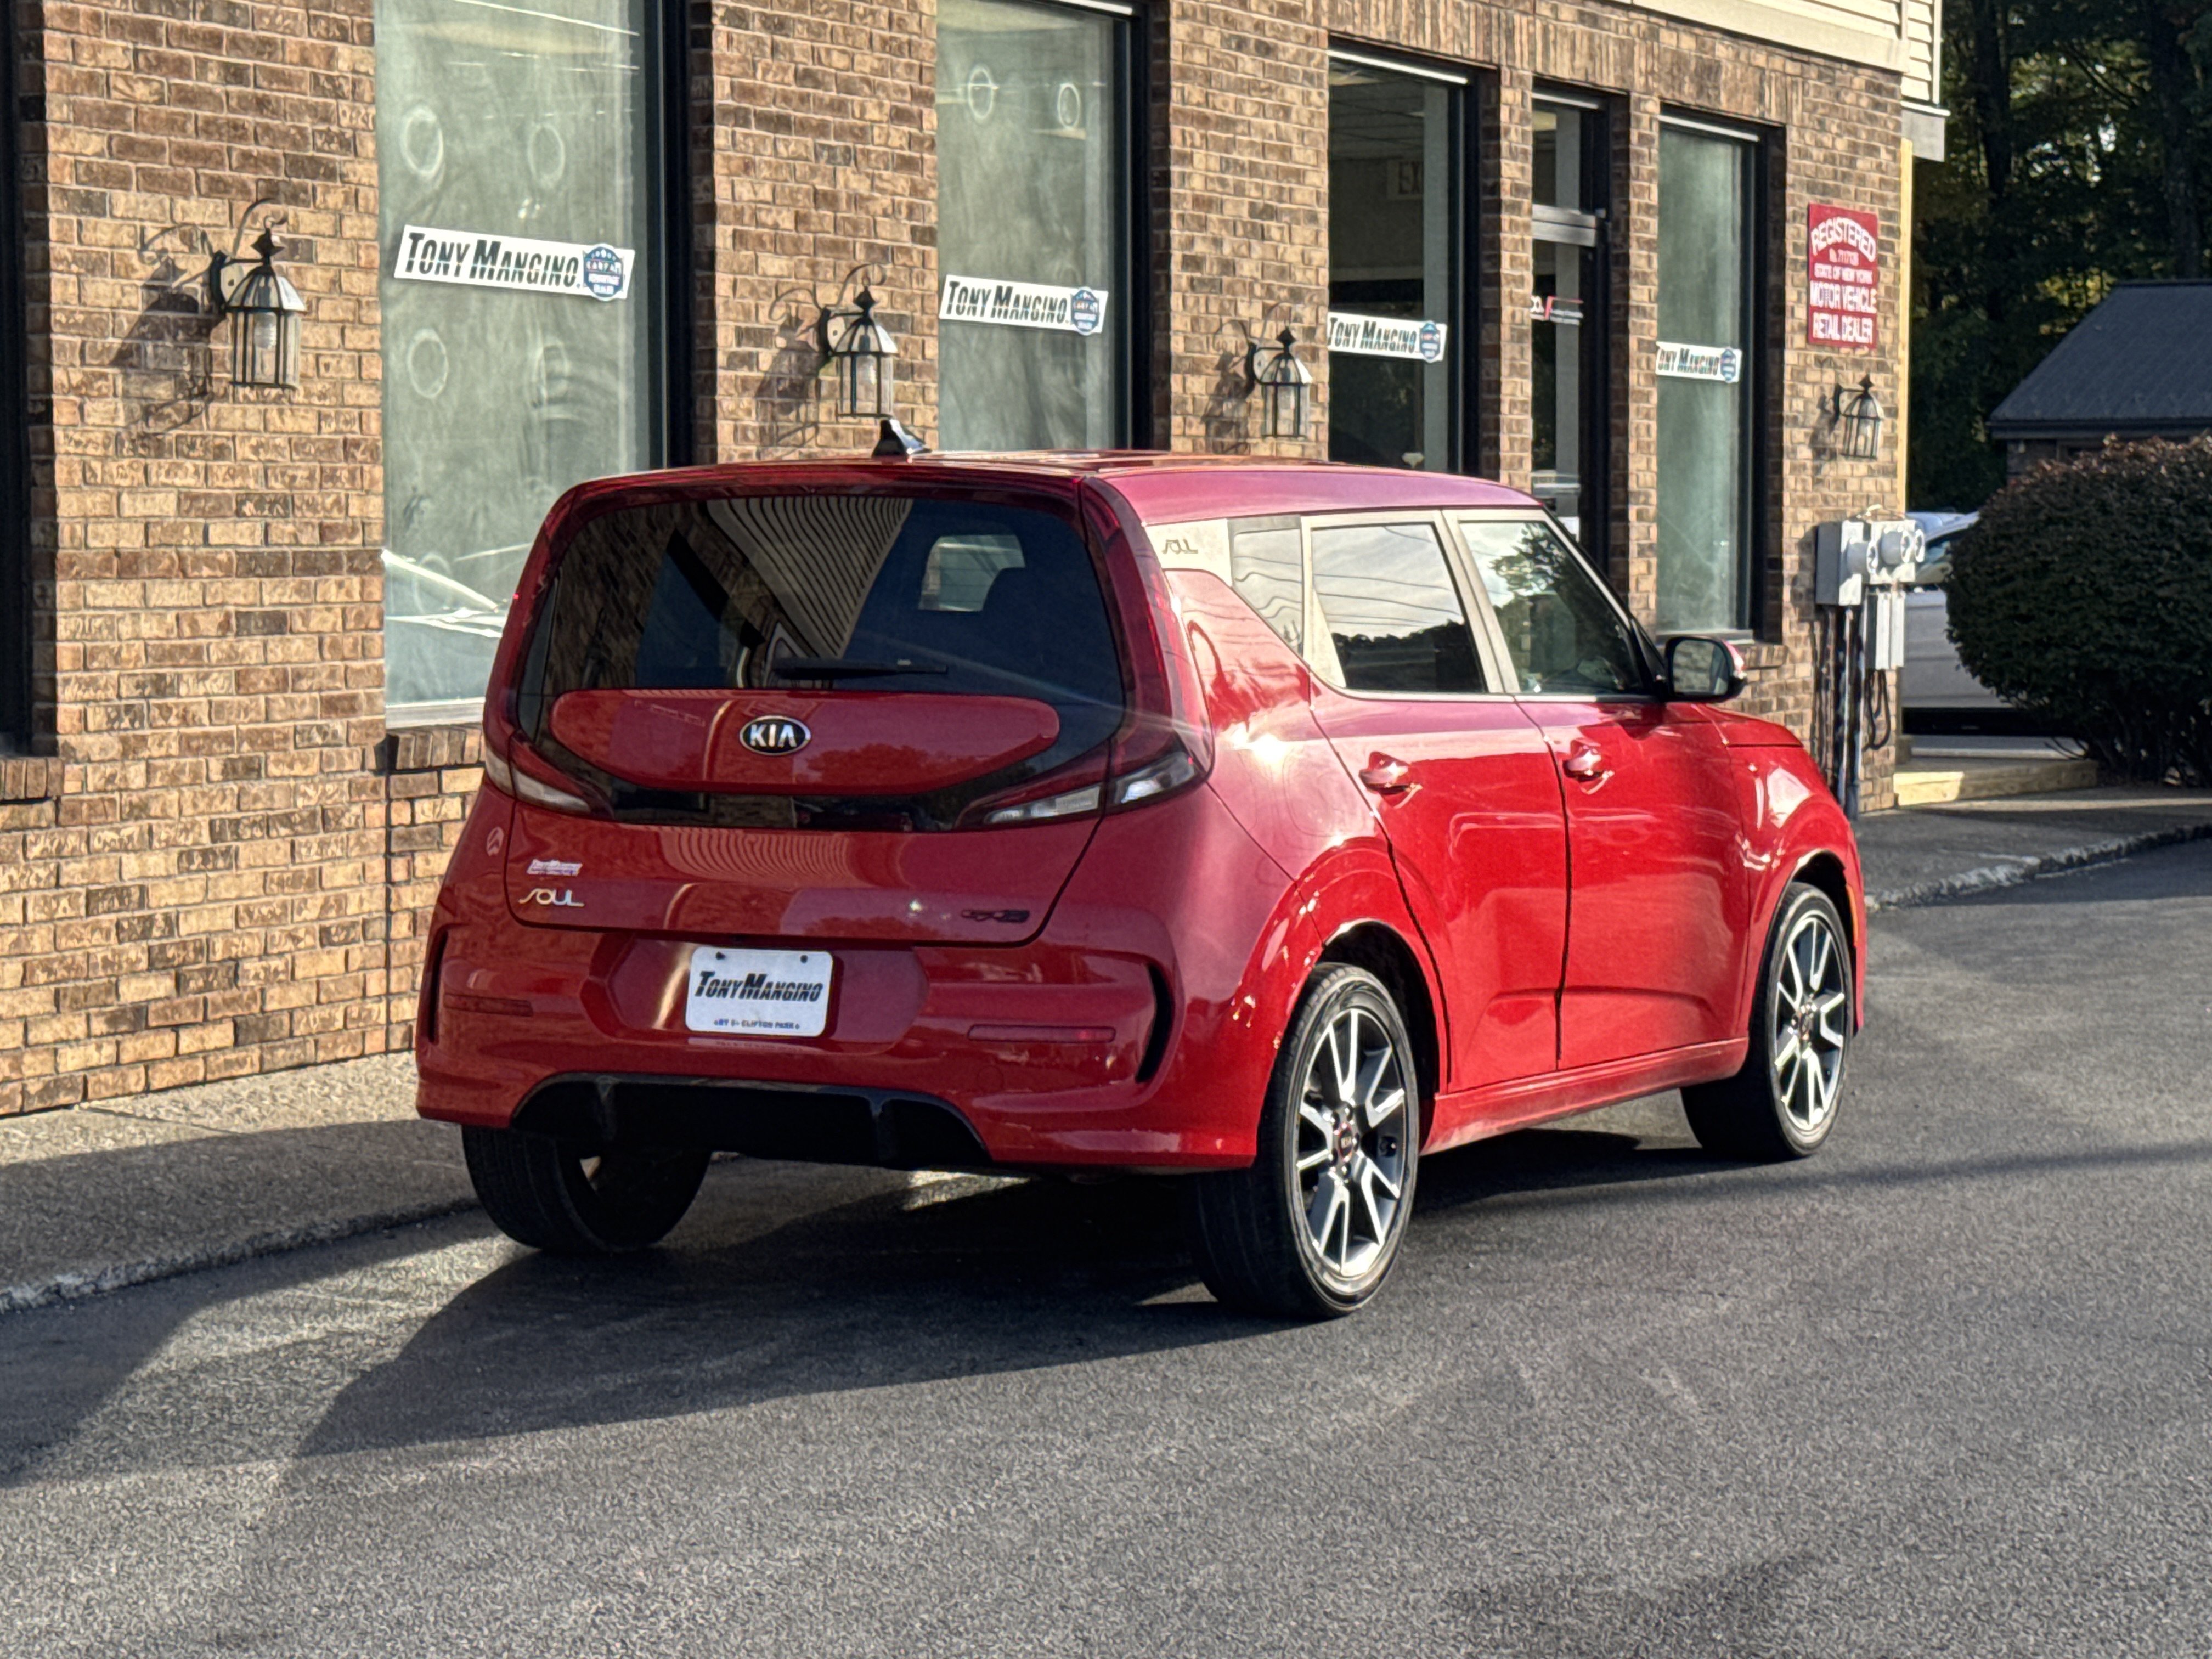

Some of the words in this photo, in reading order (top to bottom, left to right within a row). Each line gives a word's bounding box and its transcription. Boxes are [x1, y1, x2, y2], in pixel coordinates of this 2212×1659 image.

[1811, 217, 1876, 263] REGISTERED
[405, 232, 470, 277] TONY
[469, 239, 579, 287] MANGINO
[946, 280, 991, 317] TONY
[990, 285, 1068, 324] MANGINO
[1810, 280, 1841, 310] MOTOR
[1842, 285, 1877, 314] VEHICLE
[1328, 317, 1361, 348] TONY
[1359, 320, 1417, 354] MANGINO
[1813, 312, 1841, 341] RETAIL
[1841, 315, 1873, 345] DEALER
[1658, 349, 1678, 371] ONY
[750, 724, 797, 747] KIA
[518, 888, 584, 907] SOUL
